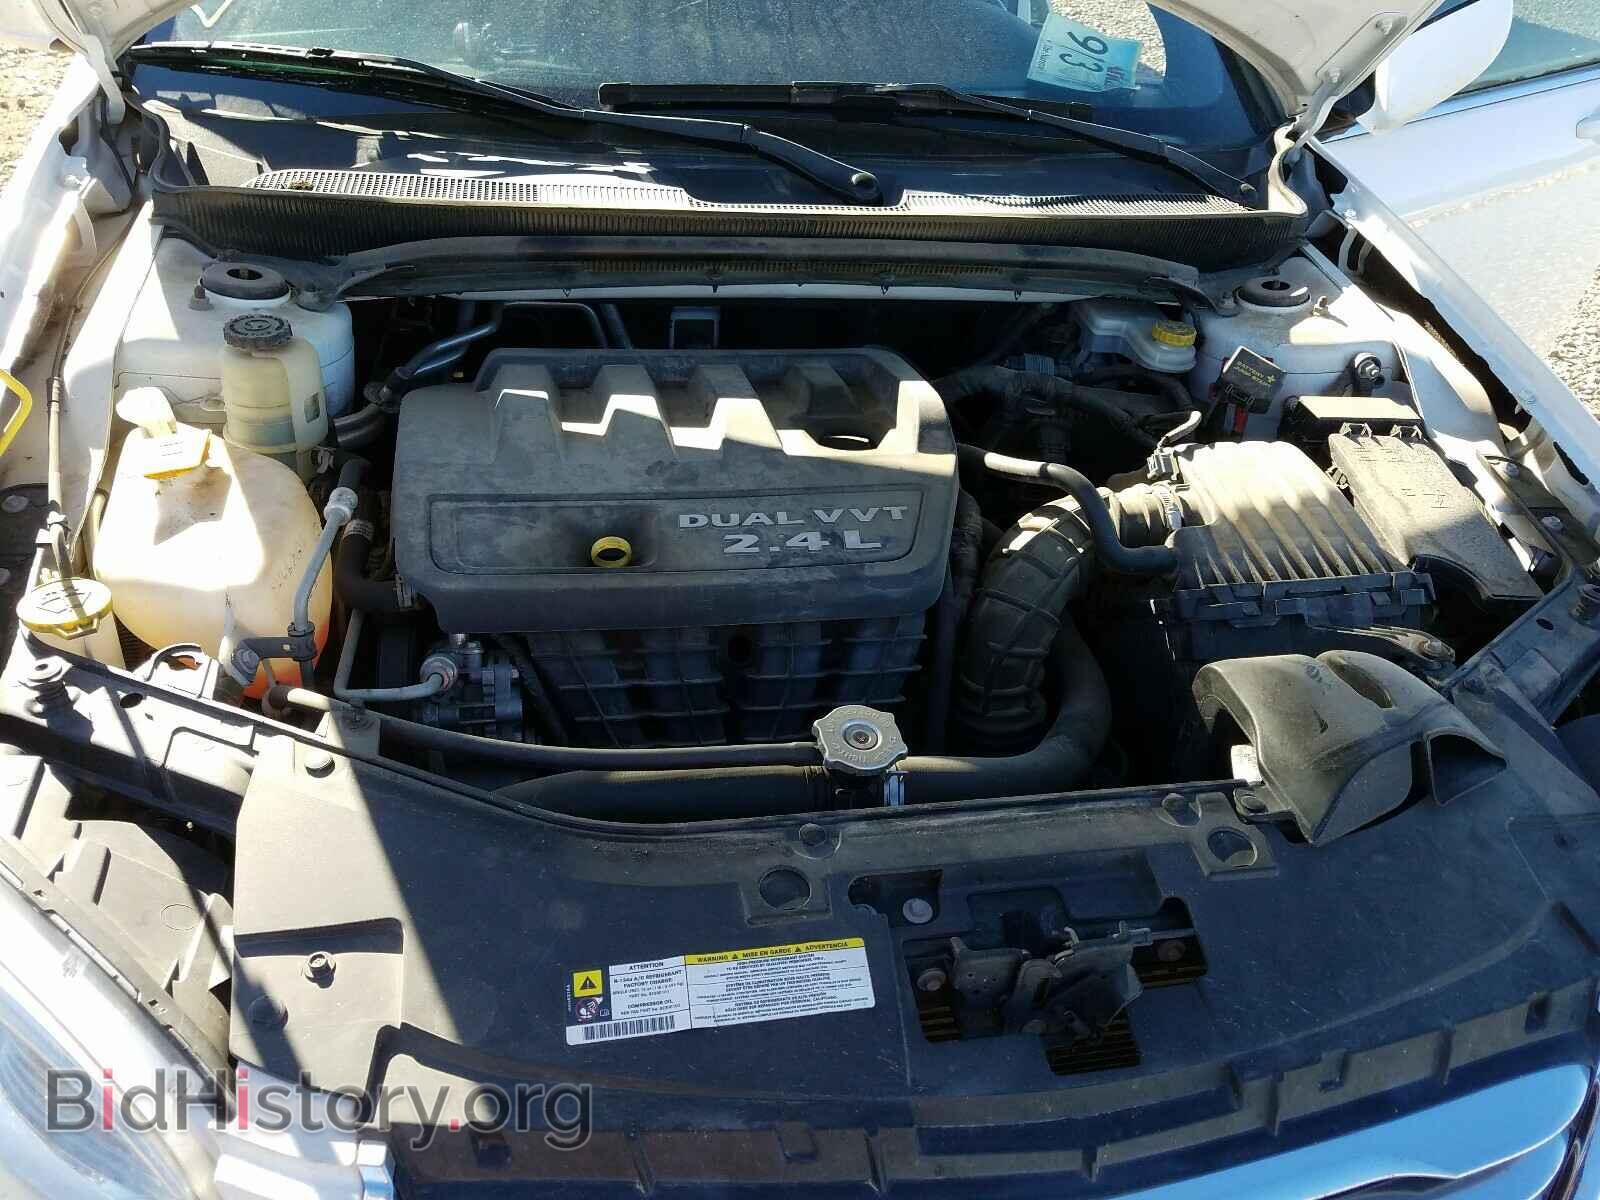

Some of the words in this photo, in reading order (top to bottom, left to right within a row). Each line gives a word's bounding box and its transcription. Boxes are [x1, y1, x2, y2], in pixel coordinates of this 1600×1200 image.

[679, 511, 805, 528] DUAL
[813, 506, 908, 523] VVT
[696, 955, 729, 963] WARNING
[629, 961, 664, 971] ATTENTION
